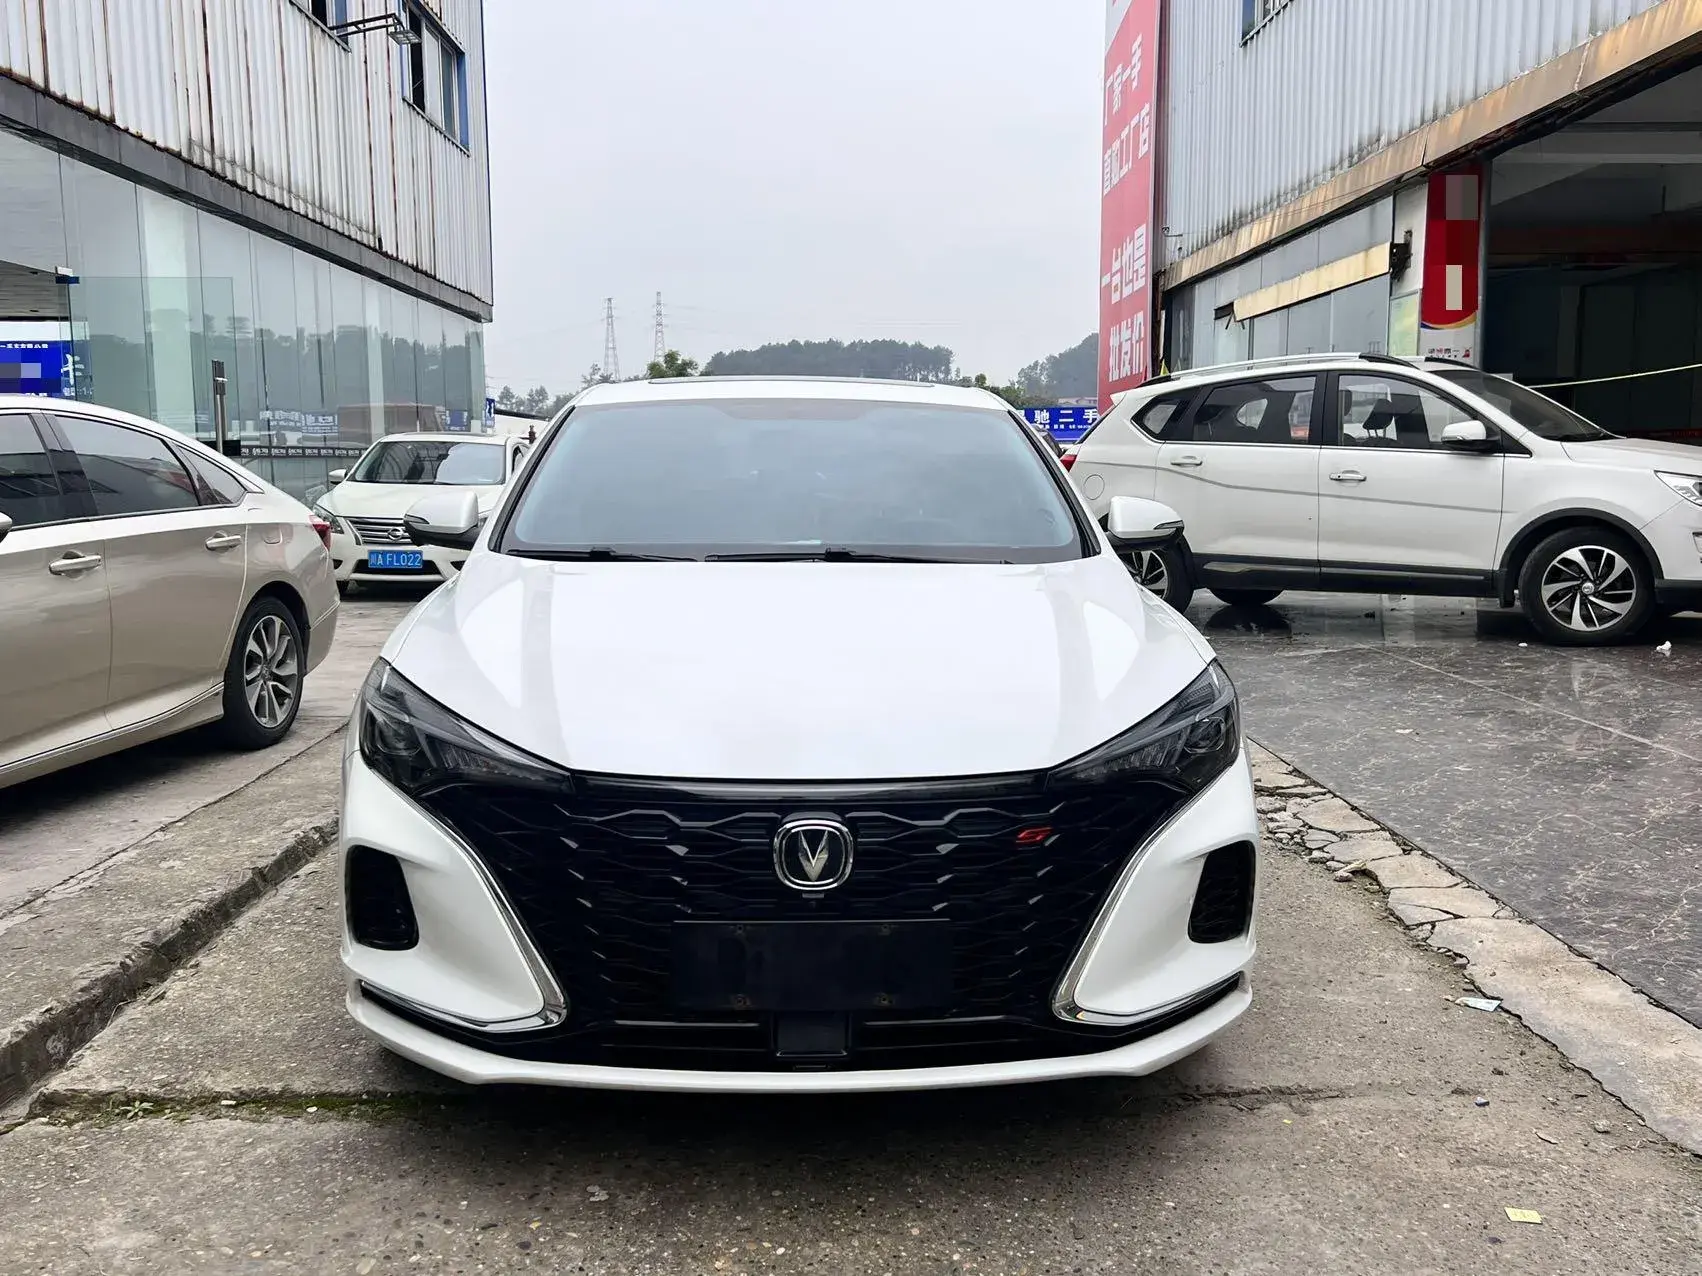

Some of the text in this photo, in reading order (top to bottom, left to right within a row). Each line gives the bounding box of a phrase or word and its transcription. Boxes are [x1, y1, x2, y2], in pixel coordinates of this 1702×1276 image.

[1101, 224, 1146, 305] 一台也是
[1109, 311, 1145, 382] 批发价
